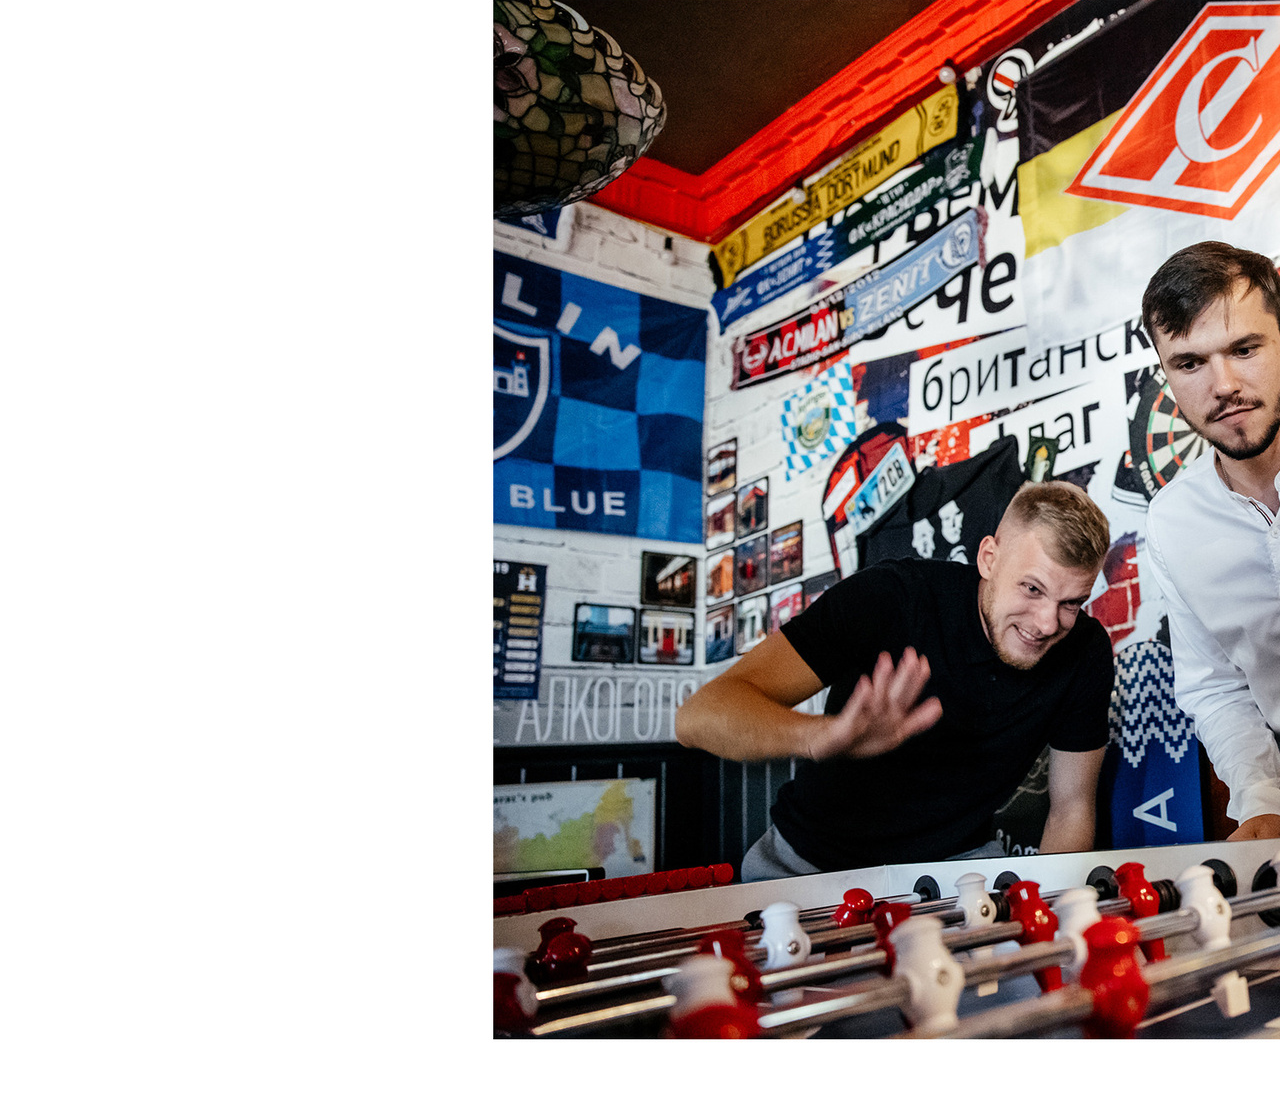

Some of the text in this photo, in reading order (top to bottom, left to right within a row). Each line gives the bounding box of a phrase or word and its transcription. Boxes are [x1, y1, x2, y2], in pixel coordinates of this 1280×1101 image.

[762, 189, 822, 246] BORUSSIA
[826, 138, 901, 205] DORTMUND
[857, 248, 939, 324] ZENIT
[509, 484, 627, 517] BLUE
